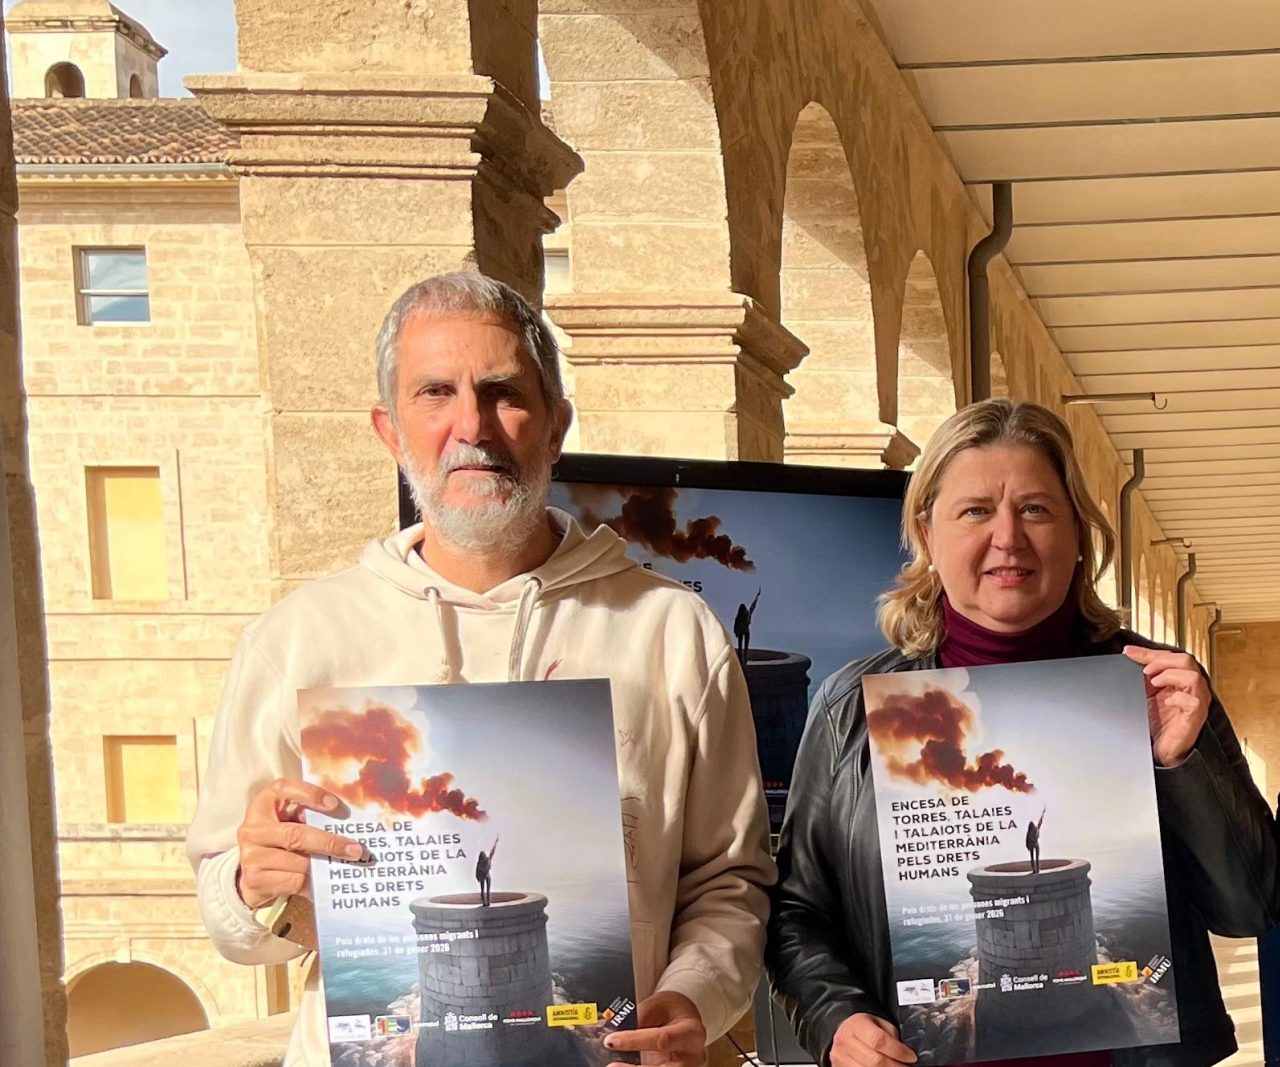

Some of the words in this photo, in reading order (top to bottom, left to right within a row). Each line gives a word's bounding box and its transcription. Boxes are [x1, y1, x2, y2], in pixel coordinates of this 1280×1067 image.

[892, 798, 946, 811] ENCESA
[952, 796, 969, 806] DE
[893, 812, 950, 825] TORRES,
[955, 806, 1012, 820] TALAIES
[325, 822, 386, 834] ENCESA
[393, 821, 413, 832] DE
[904, 824, 971, 838] TALAIOTS
[976, 822, 994, 832] DE
[999, 820, 1018, 830] LA
[396, 834, 461, 846] TALAIES
[896, 834, 1000, 853] MEDITERRÀNIA
[421, 850, 440, 861] DE
[446, 849, 467, 859] LA
[897, 855, 931, 867] PELS
[937, 851, 980, 864] DRETS
[329, 863, 447, 879] MEDITERRÀNIA
[899, 867, 959, 881] HUMANS
[331, 883, 369, 894] PELS
[376, 880, 424, 892] DRETS
[332, 896, 400, 910] HUMANS
[439, 930, 474, 941] migrants
[1013, 974, 1039, 983] Consell
[1149, 959, 1171, 984] IRMU
[488, 1012, 498, 1021] de
[611, 1001, 636, 1027] IRMU
